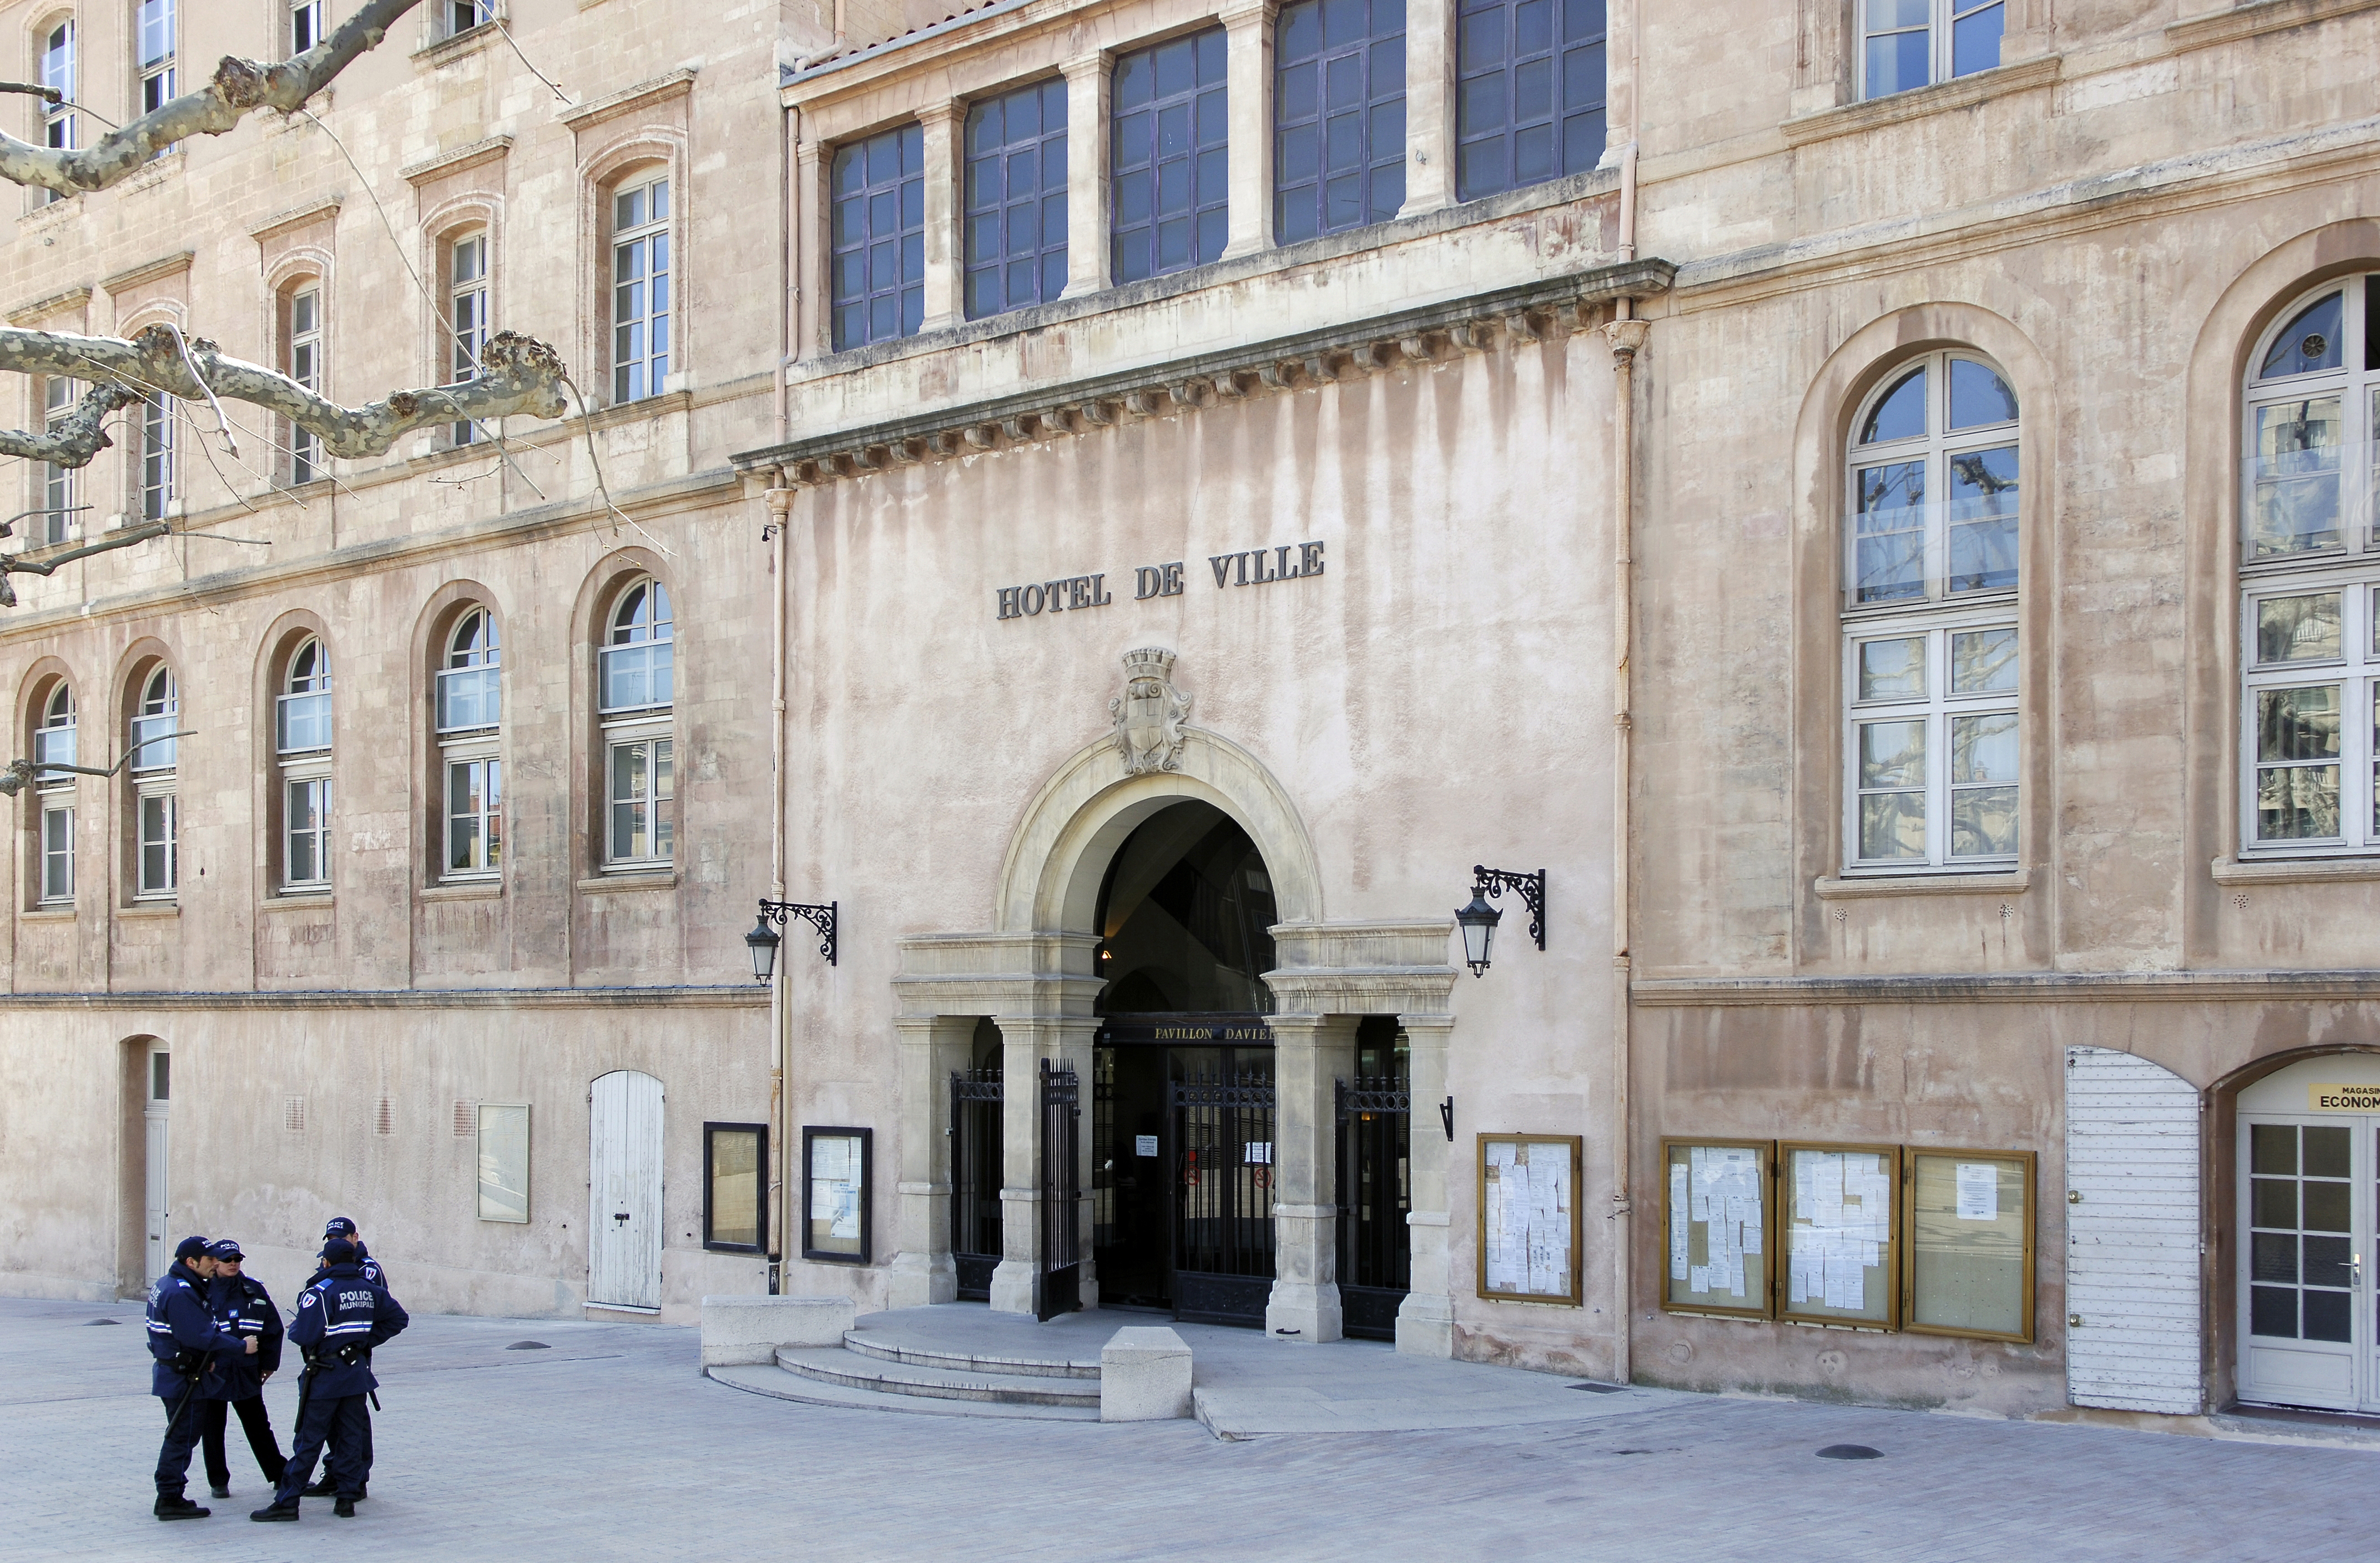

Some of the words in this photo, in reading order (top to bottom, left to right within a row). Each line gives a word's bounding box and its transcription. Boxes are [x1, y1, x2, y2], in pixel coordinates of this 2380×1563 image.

[996, 573, 1111, 620] HOTEL
[1134, 562, 1184, 600] DE
[1208, 541, 1324, 589] VILLE
[1155, 1028, 1213, 1040] PAVILLON
[339, 1290, 374, 1303] POLICE
